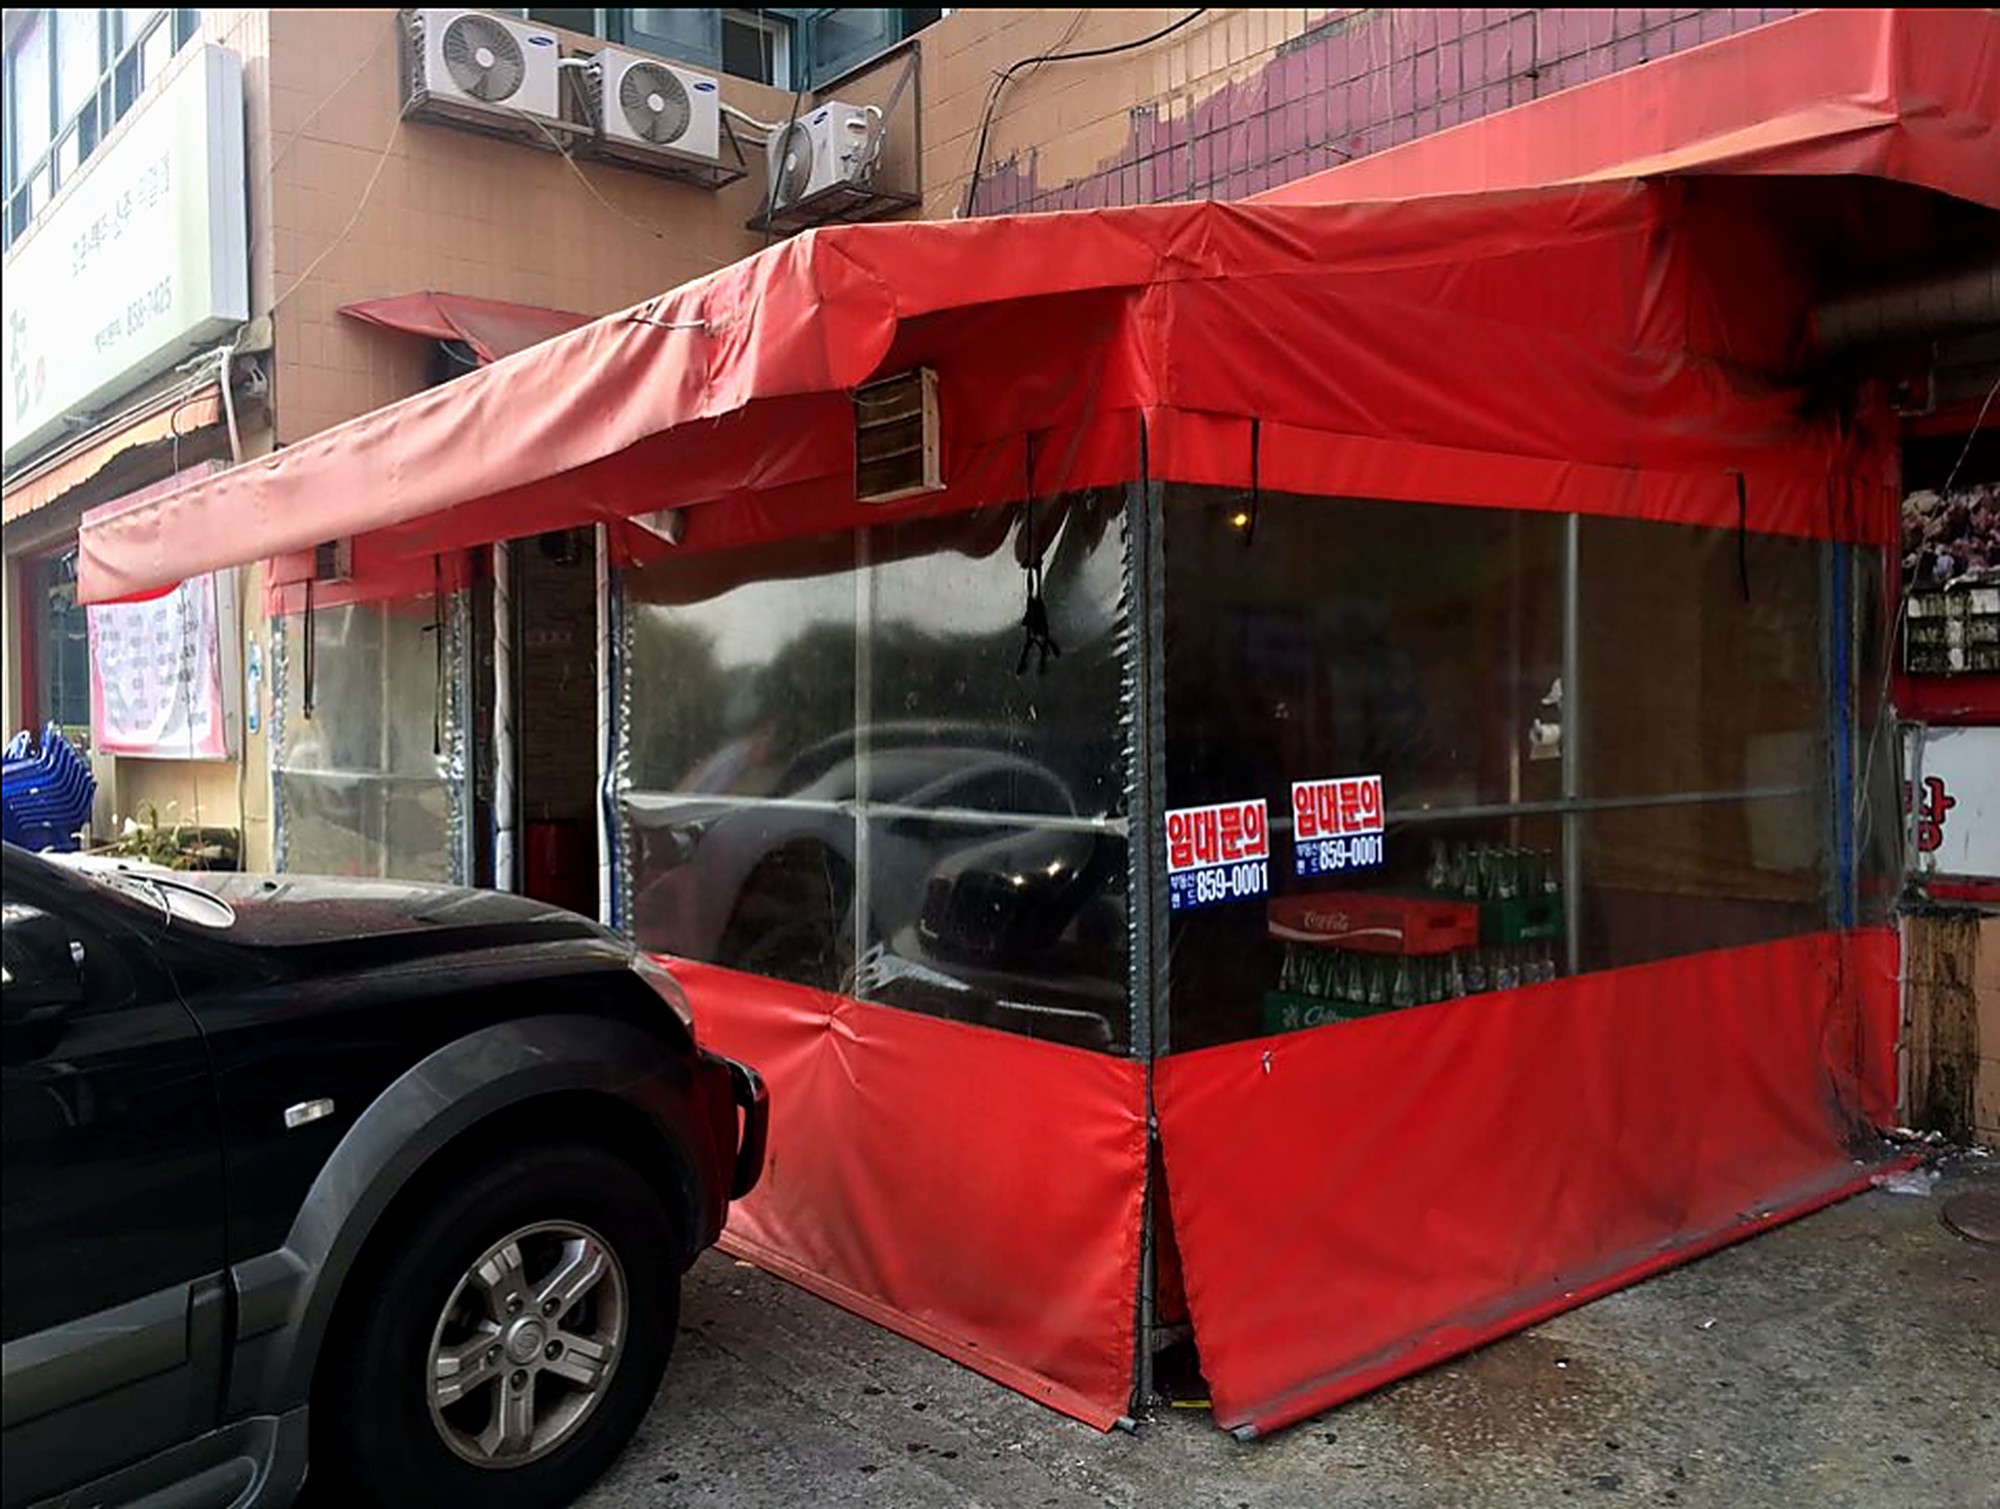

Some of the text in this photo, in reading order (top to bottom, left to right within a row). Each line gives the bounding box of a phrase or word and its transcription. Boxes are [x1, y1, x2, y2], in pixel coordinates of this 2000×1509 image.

[1295, 780, 1382, 837] 임대문의
[1168, 804, 1267, 867] 임대문의
[1319, 836, 1382, 870] 859-0001
[1197, 862, 1268, 902] 859-0001
